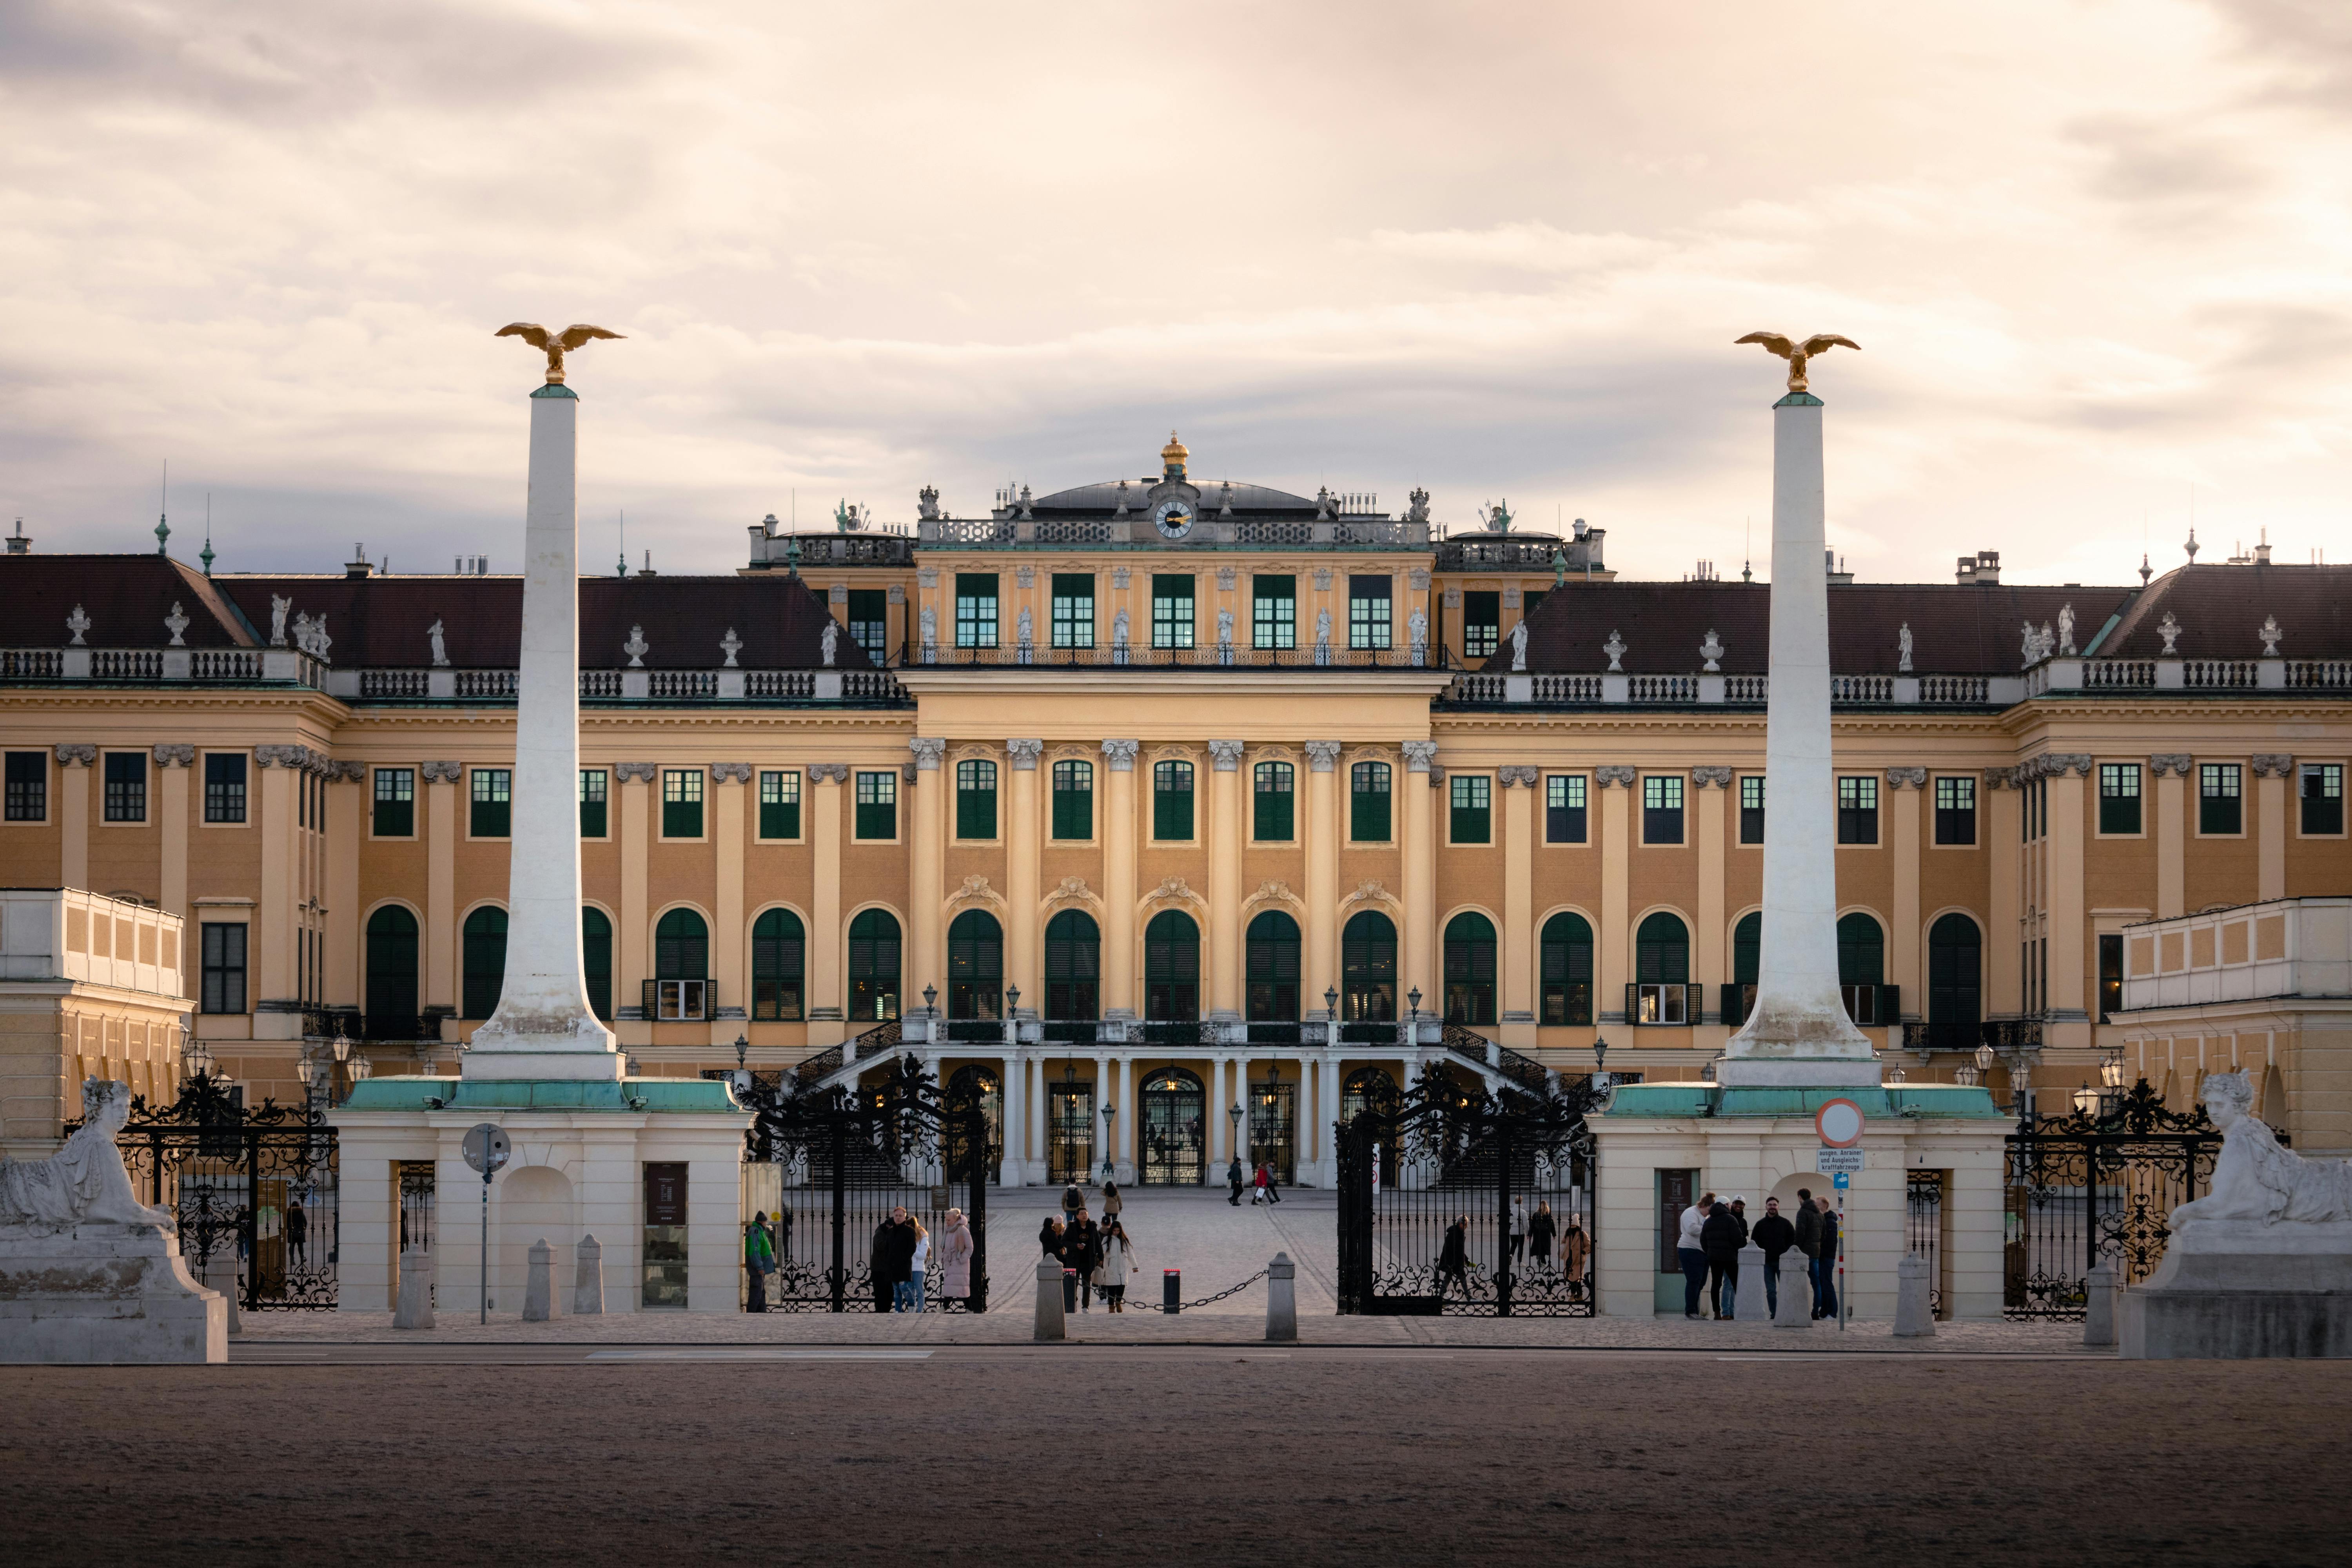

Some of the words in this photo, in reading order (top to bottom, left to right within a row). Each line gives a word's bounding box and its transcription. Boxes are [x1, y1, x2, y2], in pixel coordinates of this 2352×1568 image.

[1163, 503, 1171, 512] XI
[1171, 529, 1176, 538] VI
[1178, 528, 1184, 536] V
